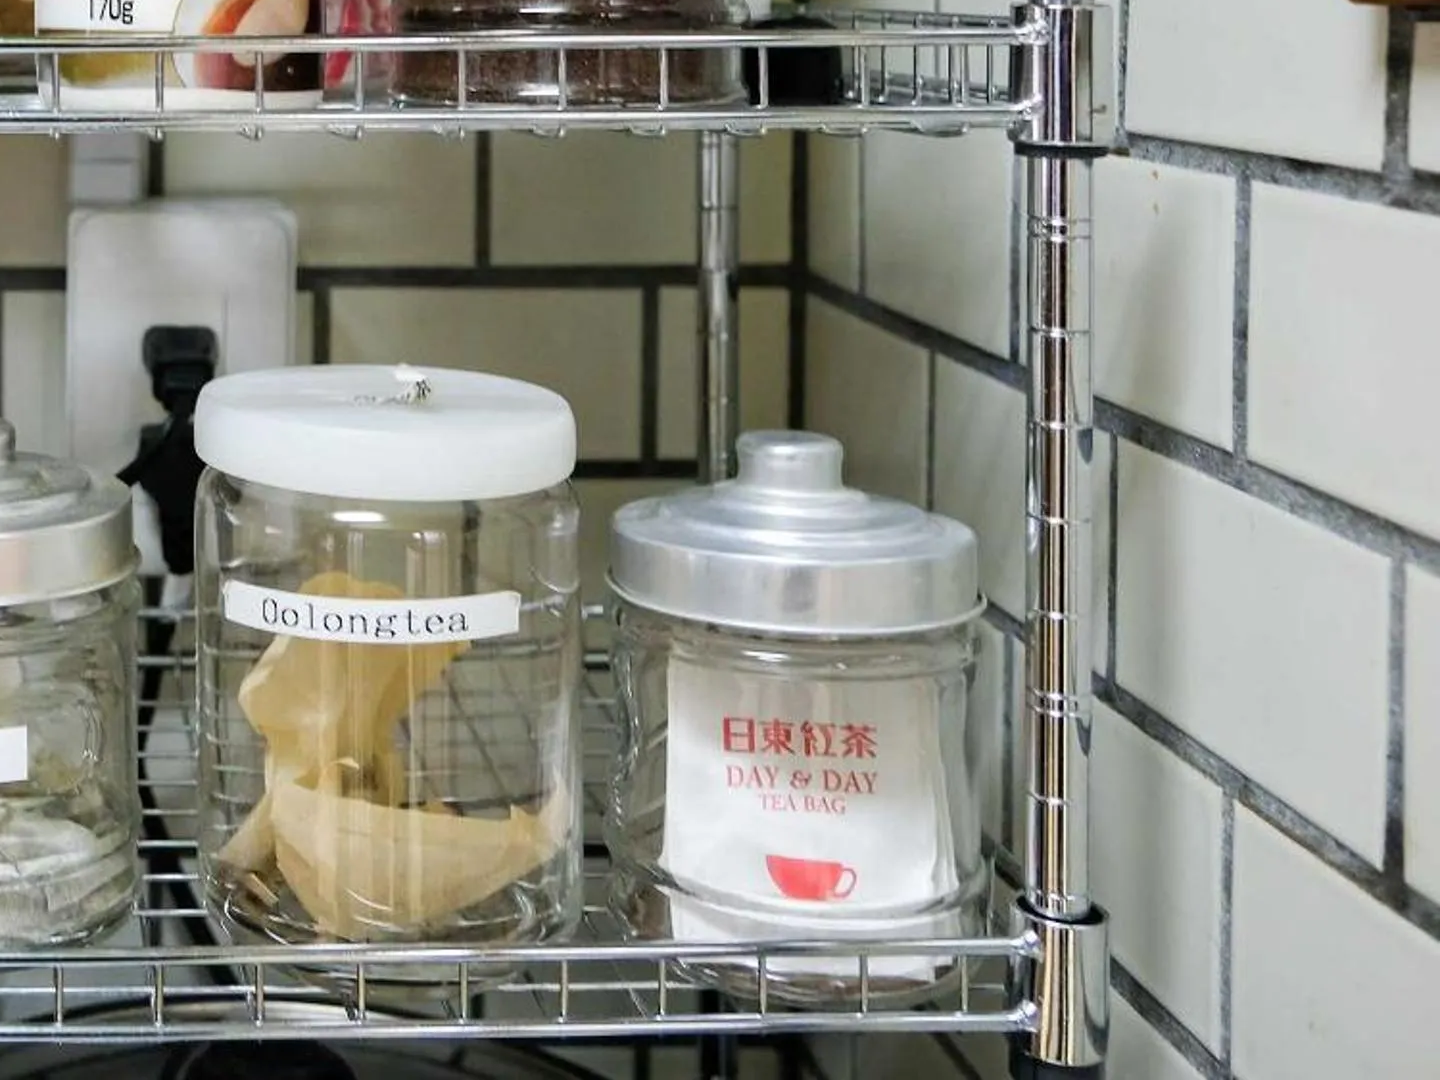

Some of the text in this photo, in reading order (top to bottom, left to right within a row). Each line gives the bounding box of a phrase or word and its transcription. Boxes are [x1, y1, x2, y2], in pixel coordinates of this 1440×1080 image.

[262, 596, 469, 639] Oolongtea
[723, 716, 879, 758] 日東紅茶
[726, 764, 878, 795] DAY & DAY
[759, 792, 847, 815] TEA BAG
